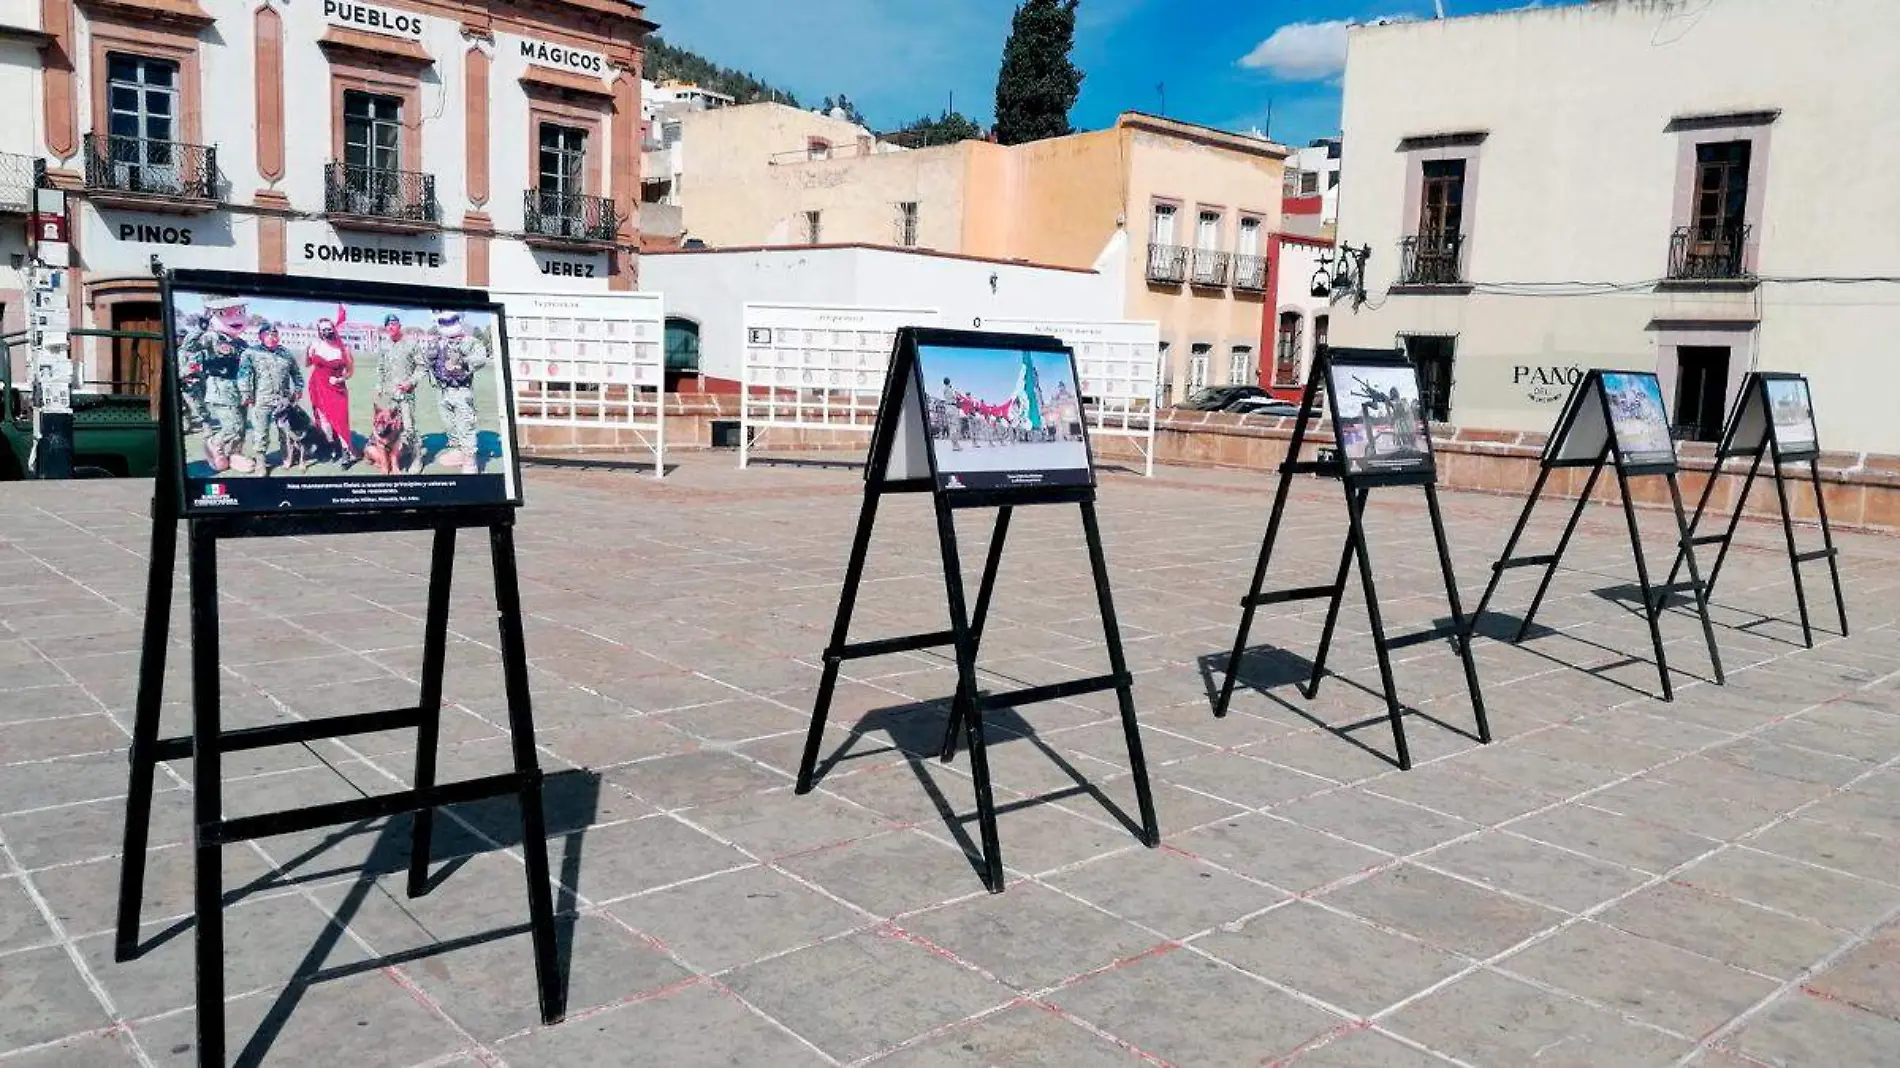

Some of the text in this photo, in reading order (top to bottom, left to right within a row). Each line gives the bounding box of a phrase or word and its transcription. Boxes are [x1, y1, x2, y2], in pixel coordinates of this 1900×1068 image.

[323, 0, 422, 35] PUEBLOS
[520, 41, 601, 72] MÁGICOS
[120, 224, 192, 245] PINOS
[304, 243, 440, 268] SOMBRERETE
[541, 260, 595, 278] JEREZ
